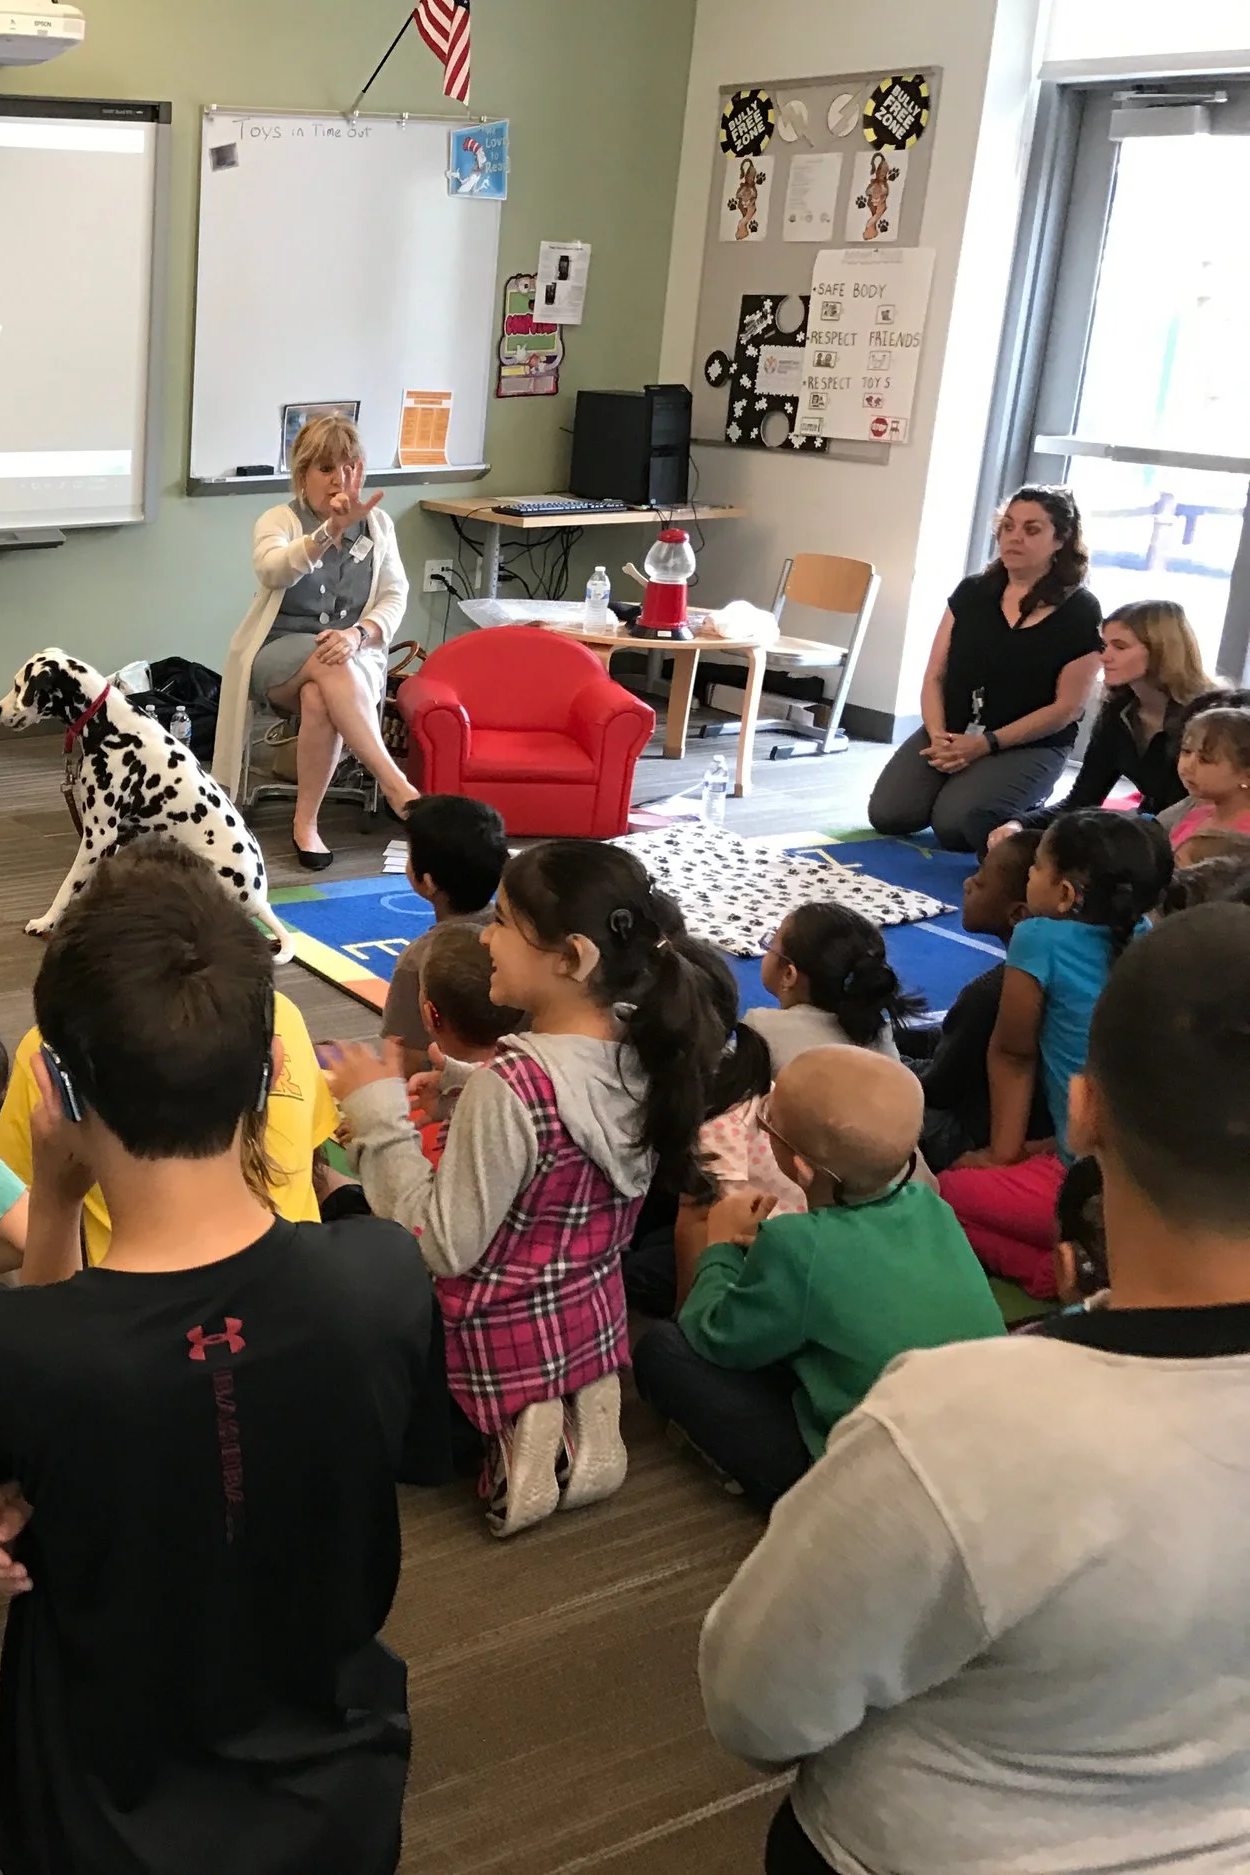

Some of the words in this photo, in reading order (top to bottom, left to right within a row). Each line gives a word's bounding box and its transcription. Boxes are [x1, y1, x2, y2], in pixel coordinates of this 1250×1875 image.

[728, 100, 758, 131] BULLY
[883, 94, 915, 130] FREE
[891, 84, 921, 116] BULLY
[232, 117, 282, 142] Toys
[291, 127, 304, 137] in
[312, 123, 342, 138] Time
[731, 109, 763, 142] FREE
[734, 120, 765, 152] ZONE
[874, 106, 906, 140] ZONE
[817, 283, 845, 297] SAFE
[853, 282, 887, 299] BODY
[810, 330, 858, 346] RESPECT
[869, 330, 920, 348] FRIENDS
[807, 375, 852, 390] RESPECT
[862, 376, 891, 389] TOYS
